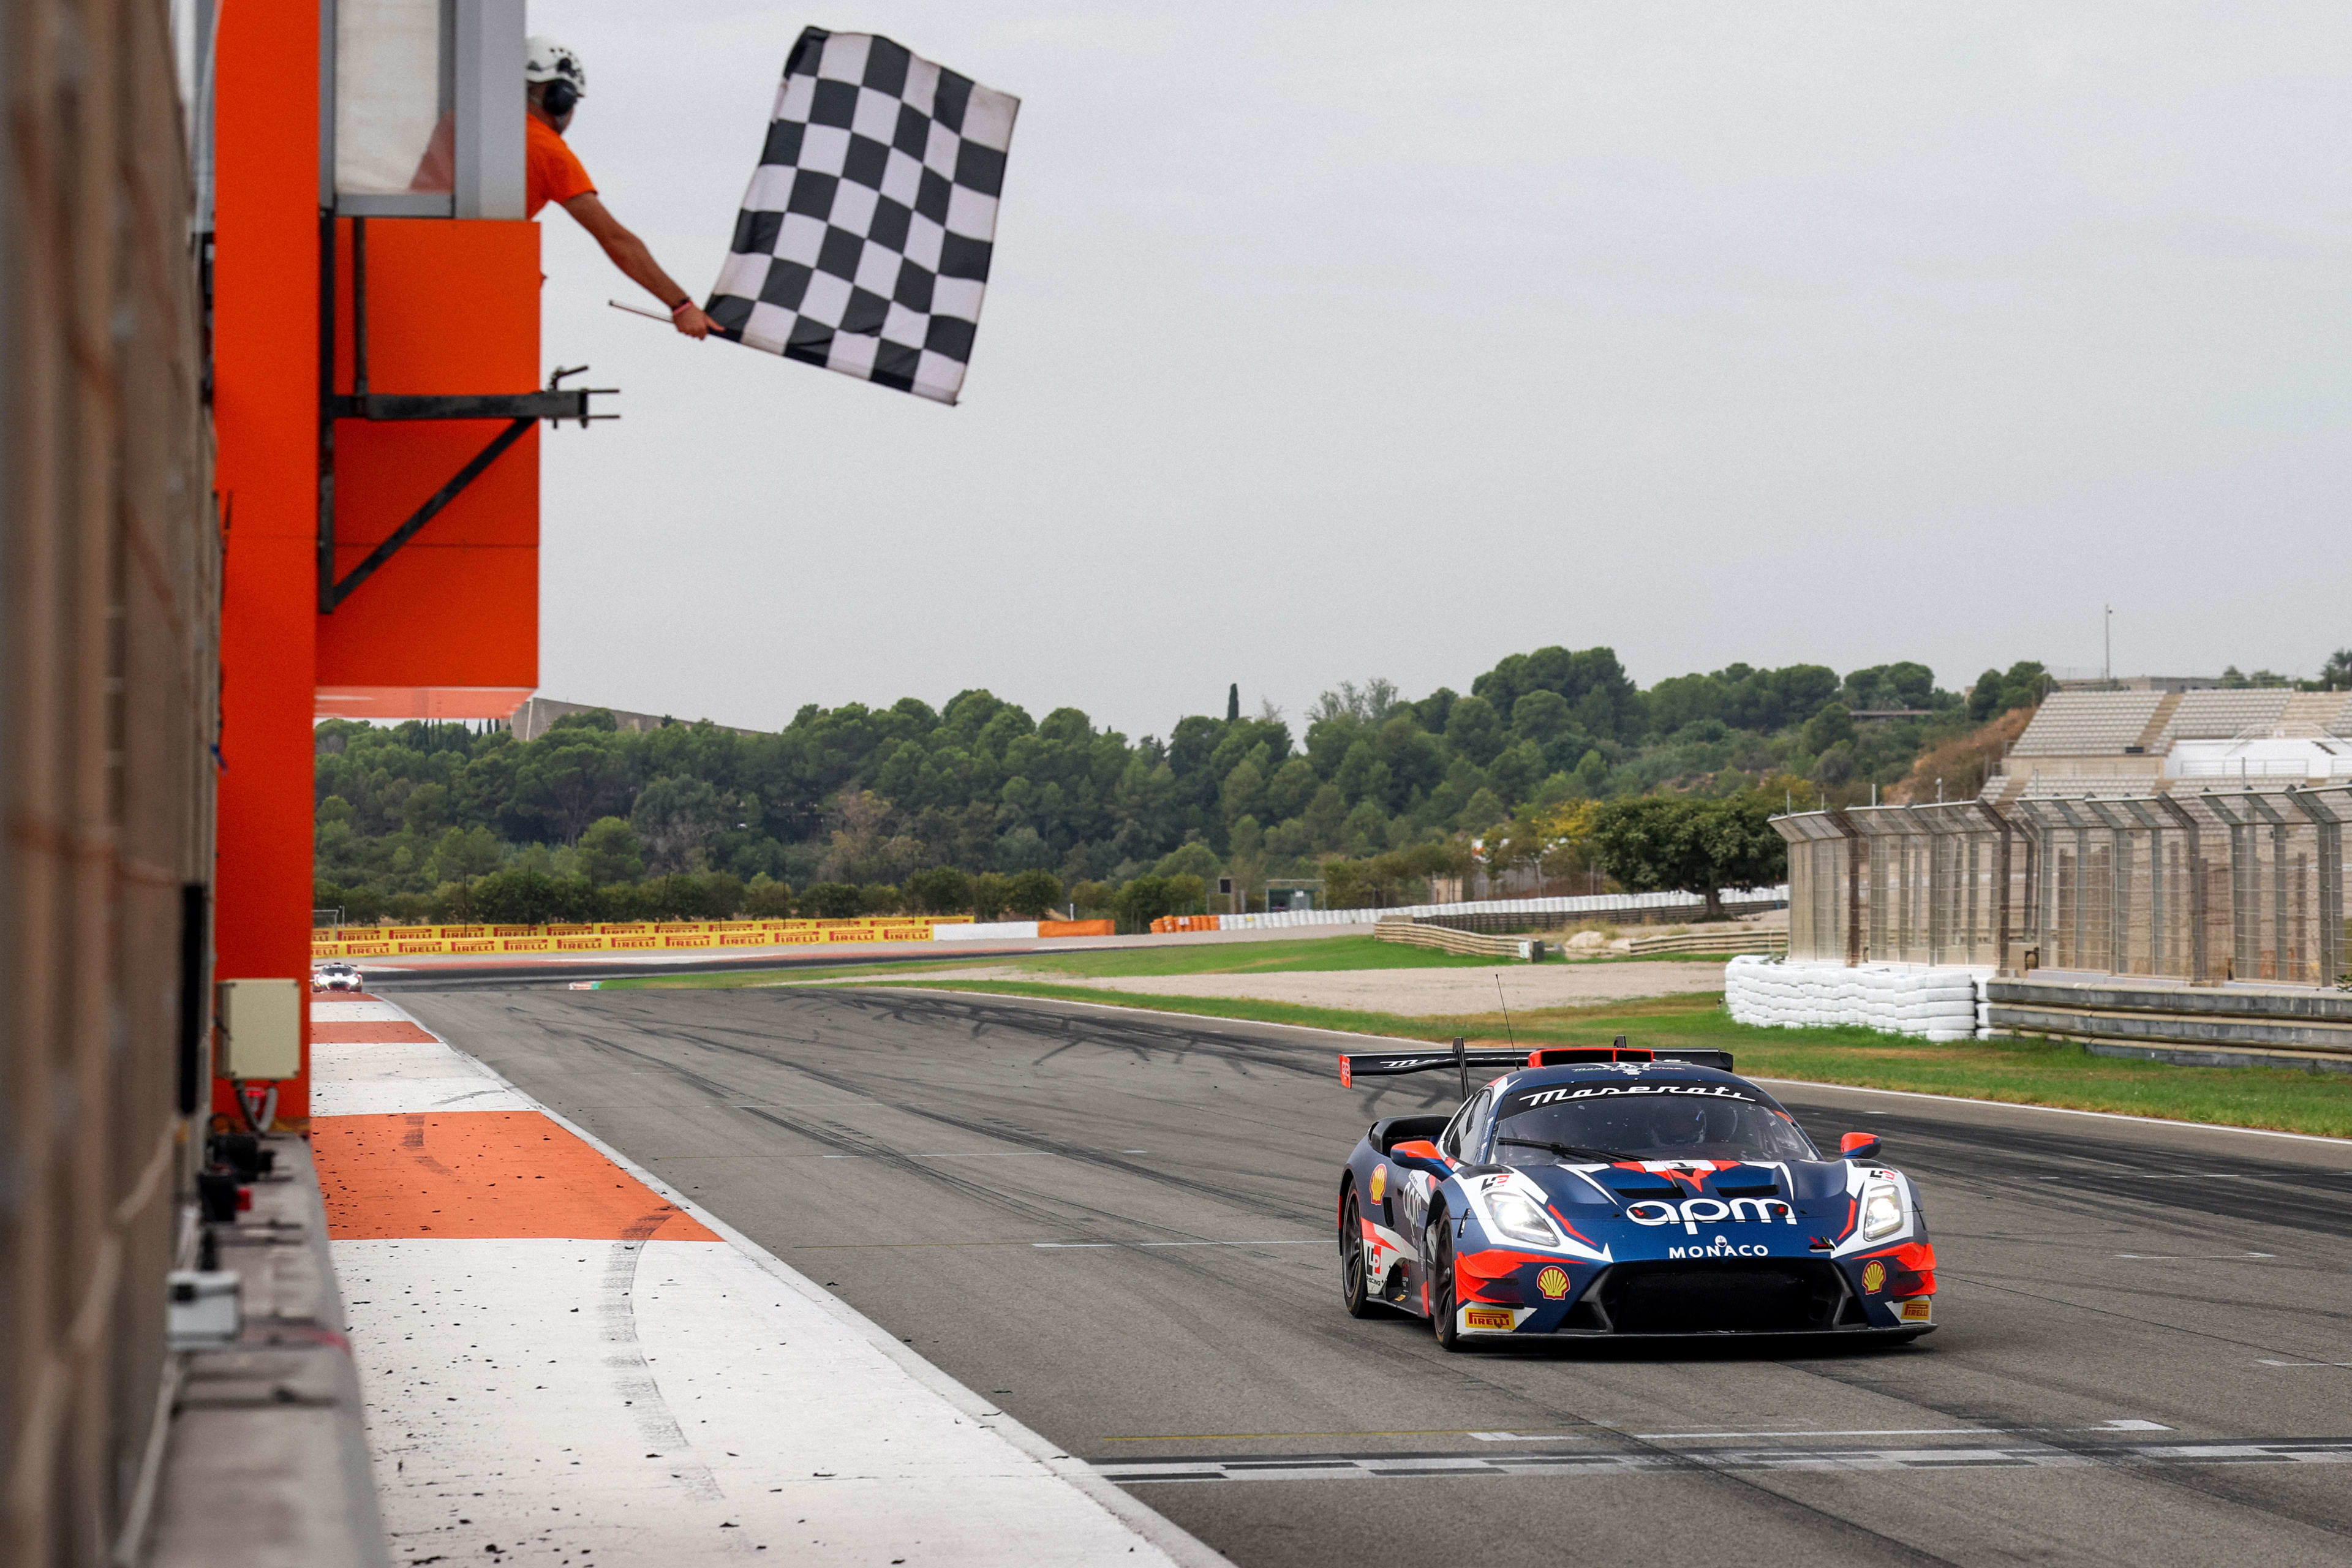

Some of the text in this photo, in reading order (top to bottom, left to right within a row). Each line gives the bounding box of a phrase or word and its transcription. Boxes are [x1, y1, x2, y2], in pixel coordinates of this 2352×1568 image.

[347, 943, 390, 954] PIRELLI
[398, 941, 442, 952] PIRELLI
[451, 940, 495, 951] PIRELLI
[503, 939, 548, 951] PIRELLI
[557, 938, 601, 949] PIRELLI
[611, 937, 655, 948] PIRELLI
[665, 935, 710, 946] PIRELLI
[720, 933, 764, 945] PIRELLI
[774, 931, 820, 943] PIRELLI
[829, 930, 874, 941] PIRELLI
[883, 929, 929, 940] PIRELLI
[1519, 1086, 1756, 1106] Maserati
[1626, 1198, 1798, 1235] apm
[1669, 1245, 1768, 1259] MONACO
[1904, 1303, 1929, 1316] PIRELLI
[1468, 1312, 1510, 1325] PIRELLI
